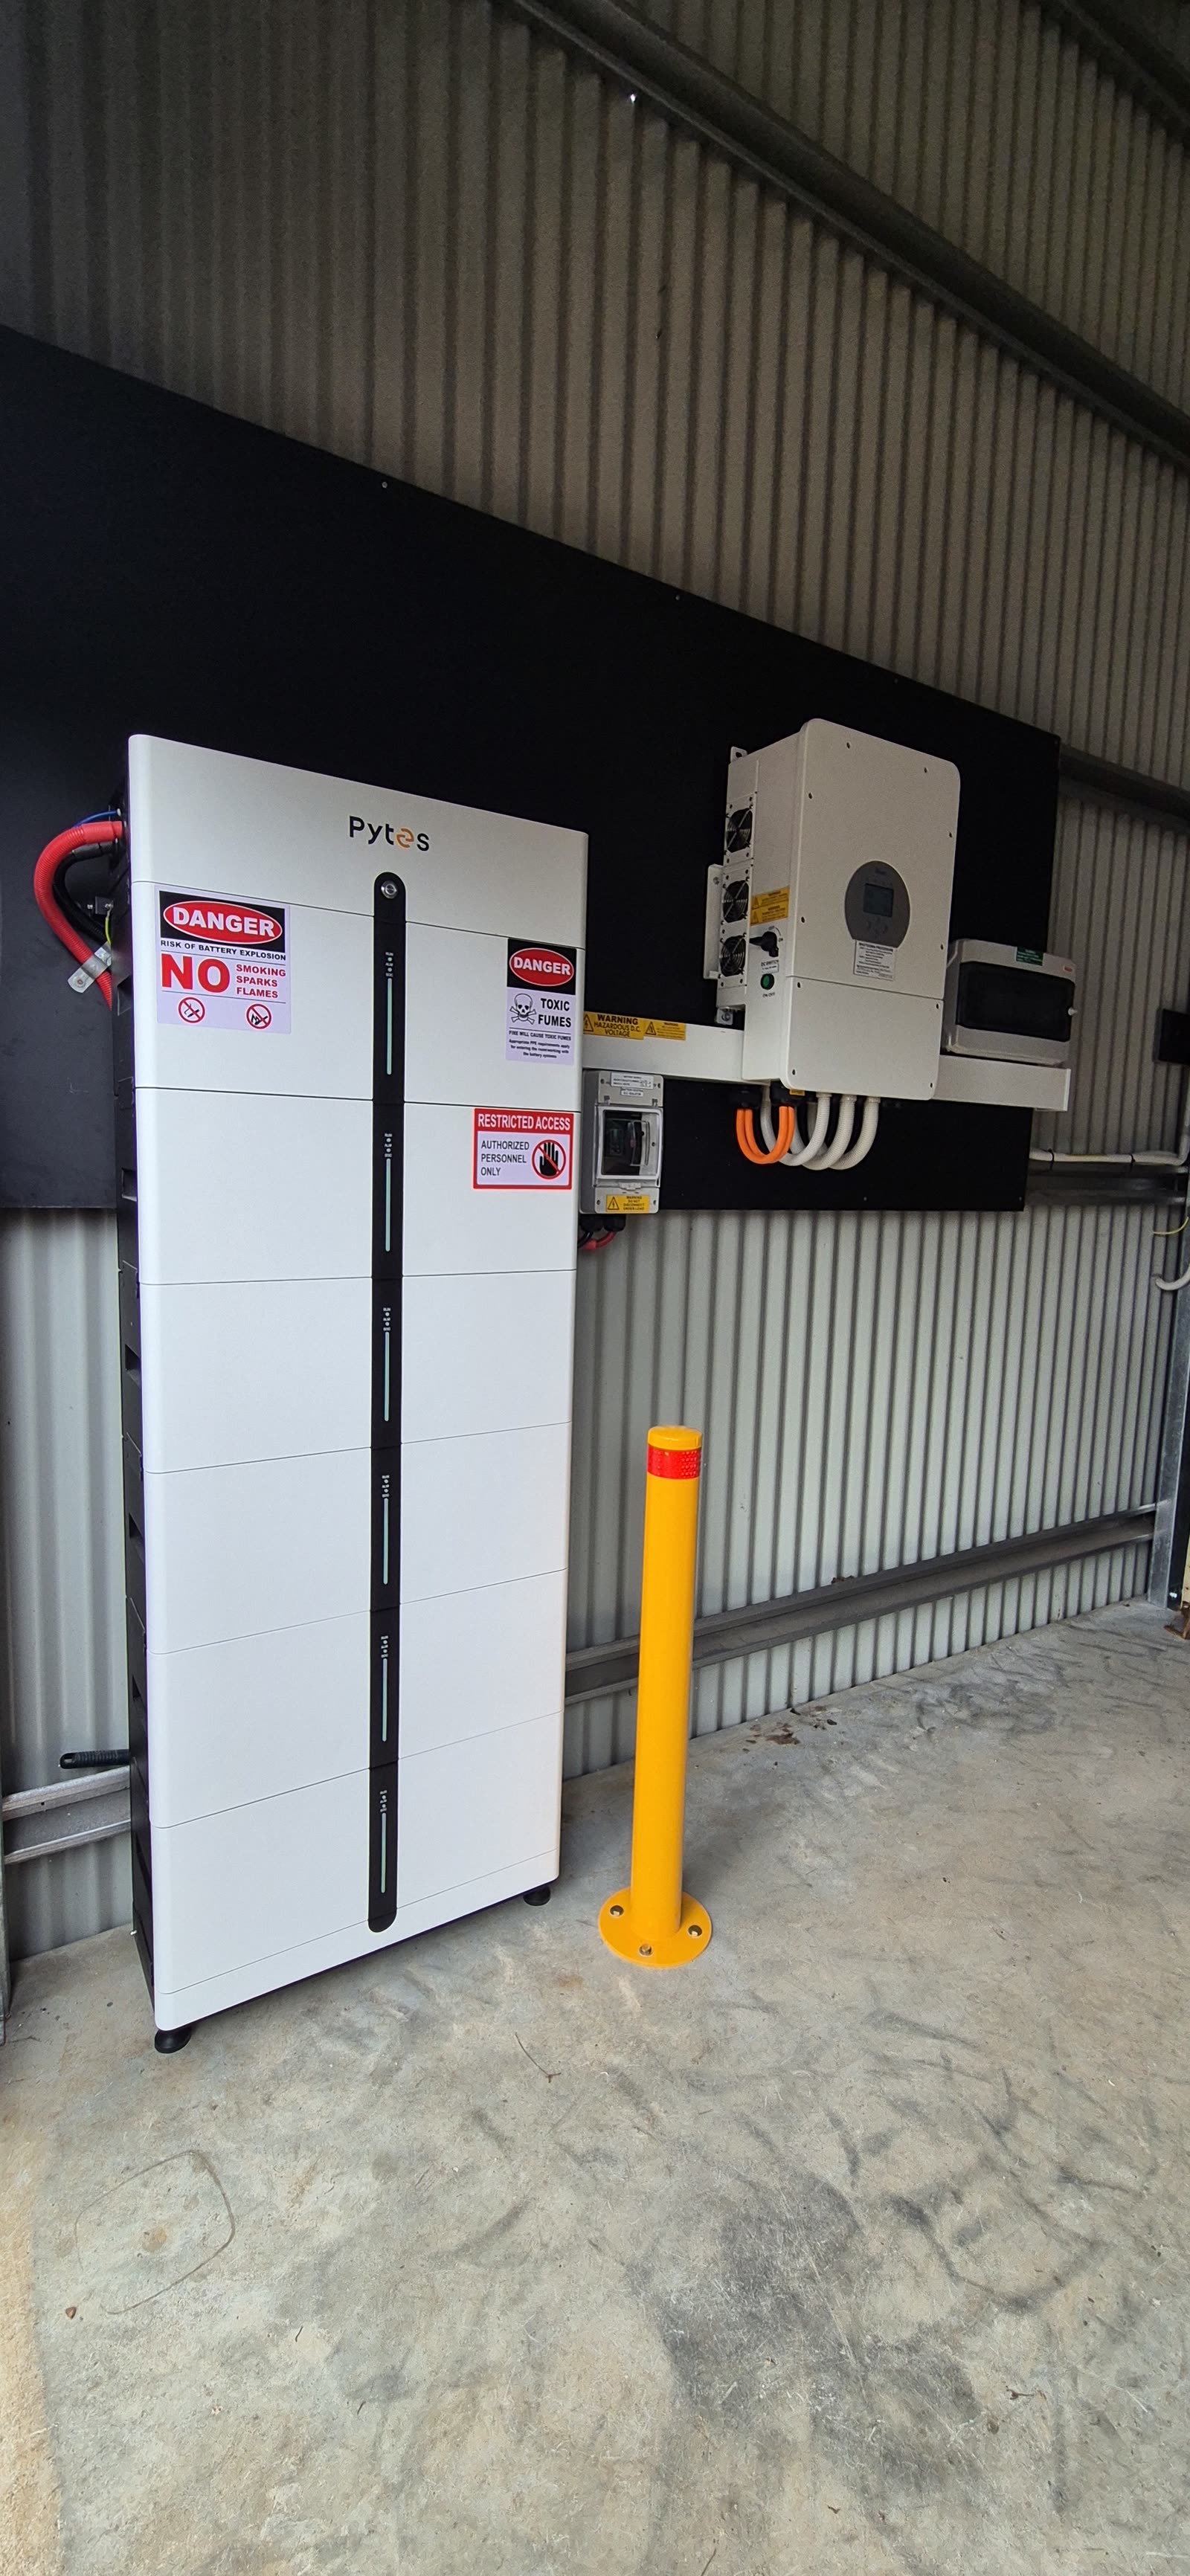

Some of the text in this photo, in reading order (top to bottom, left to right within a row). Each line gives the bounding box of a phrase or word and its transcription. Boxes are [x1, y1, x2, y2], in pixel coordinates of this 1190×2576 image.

[349, 815, 430, 851] Pytes
[173, 907, 275, 938] DANGER
[161, 940, 181, 949] RISK
[199, 944, 237, 955] BATTERY
[239, 950, 286, 961] EXPLOSION
[236, 964, 286, 977] SMOKING
[513, 956, 571, 976] DANGER
[161, 953, 231, 994] NO
[236, 976, 278, 988] SPARKS
[237, 987, 279, 999] FLAMES
[540, 998, 570, 1012] TOXIC
[538, 1014, 572, 1028] FUMES
[597, 1014, 639, 1025] WARNING
[594, 1022, 630, 1031] HAZARDOUS
[605, 1028, 631, 1037] VOLTAGE
[477, 1112, 571, 1131] RESTRICTED ACCESS
[480, 1140, 530, 1150] AUTHORIZED
[480, 1153, 527, 1164] PERSONNEL
[480, 1167, 501, 1176] ONLY
